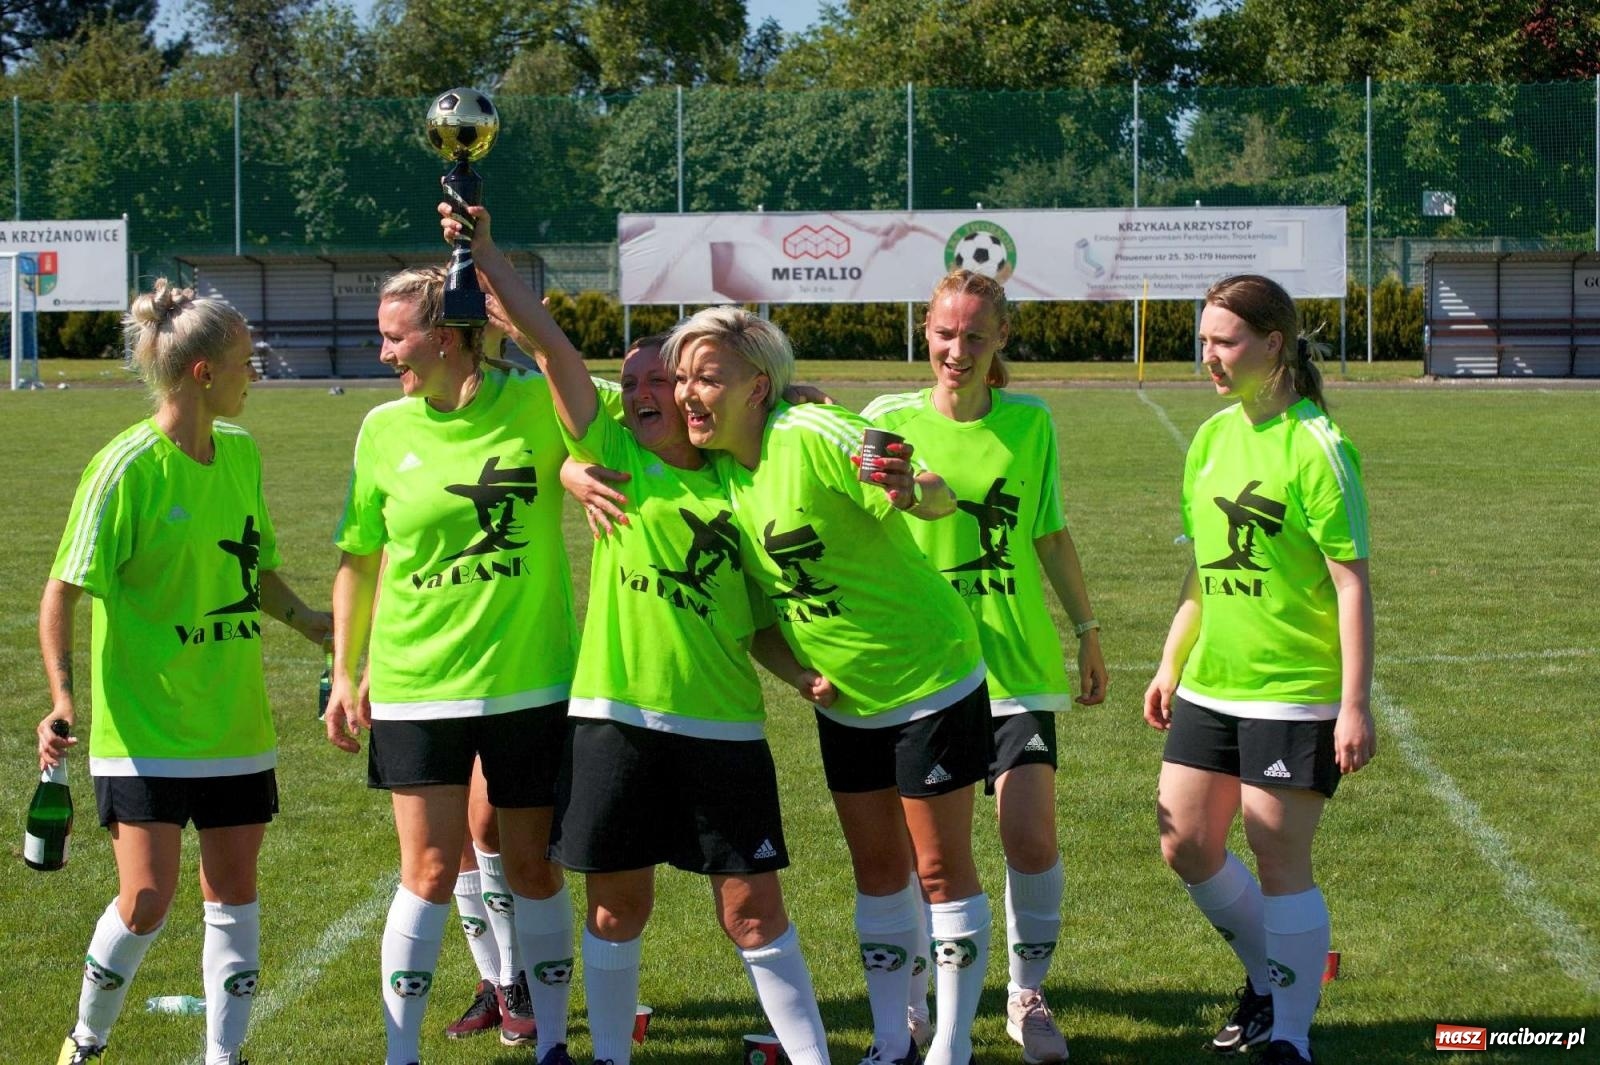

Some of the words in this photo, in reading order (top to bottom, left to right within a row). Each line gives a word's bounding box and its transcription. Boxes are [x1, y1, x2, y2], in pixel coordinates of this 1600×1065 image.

[1183, 221, 1253, 231] KRZYSZTOF
[12, 227, 119, 243] KRZYŻANOWICE
[771, 266, 863, 281] METALIO
[412, 572, 443, 590] Va
[452, 555, 531, 585] BANK
[620, 566, 649, 592] Va
[1205, 576, 1273, 598] BANK
[174, 624, 205, 646] Va
[213, 619, 261, 642] BAN
[925, 773, 951, 785] adidas
[1263, 770, 1291, 778] adidas
[753, 850, 777, 859] adidas
